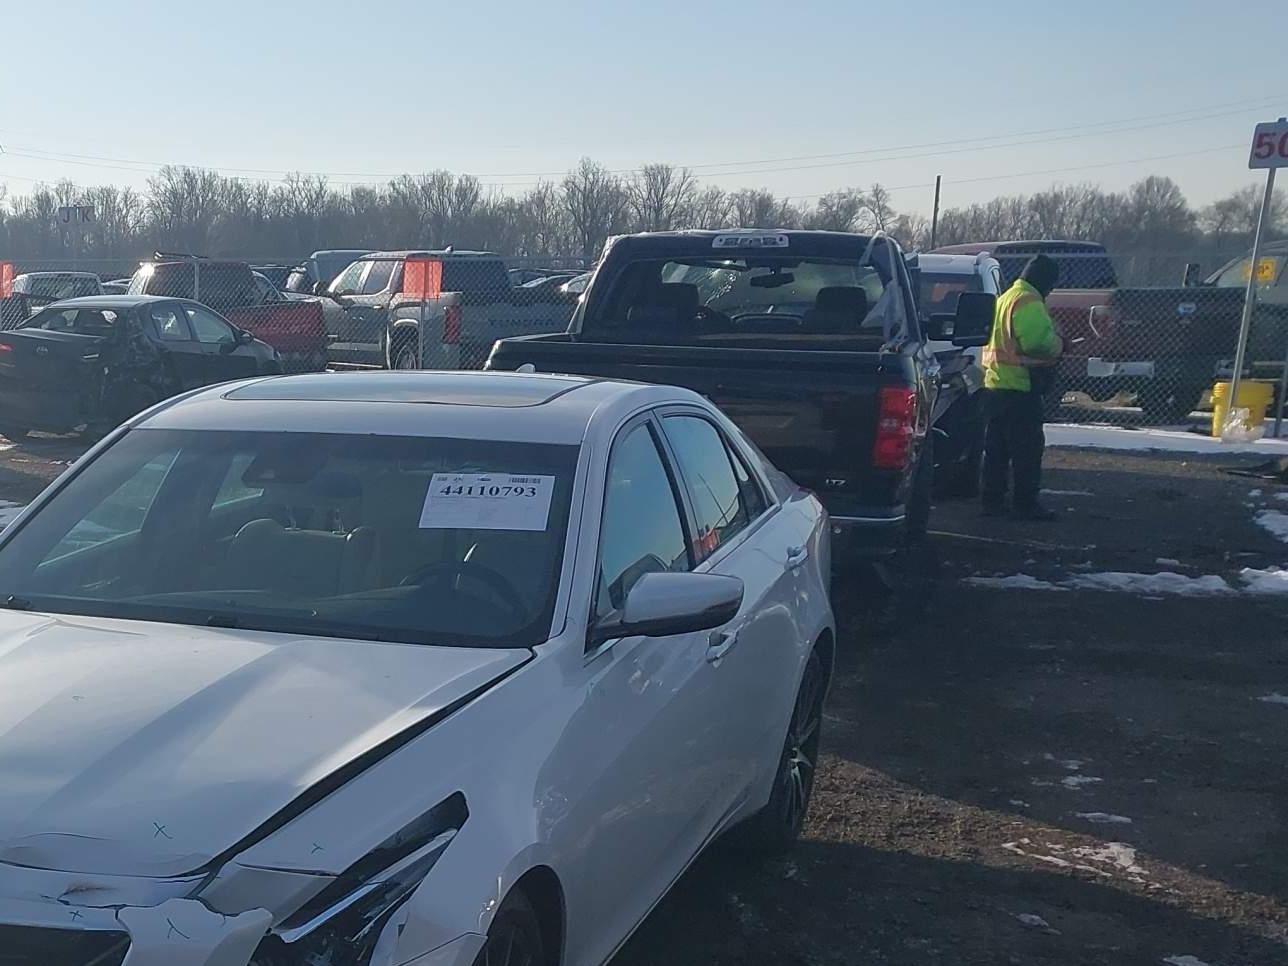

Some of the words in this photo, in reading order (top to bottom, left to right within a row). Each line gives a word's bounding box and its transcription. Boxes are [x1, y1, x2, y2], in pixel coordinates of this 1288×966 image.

[62, 209, 71, 224] J
[82, 209, 91, 223] K
[439, 485, 537, 498] 44110793
